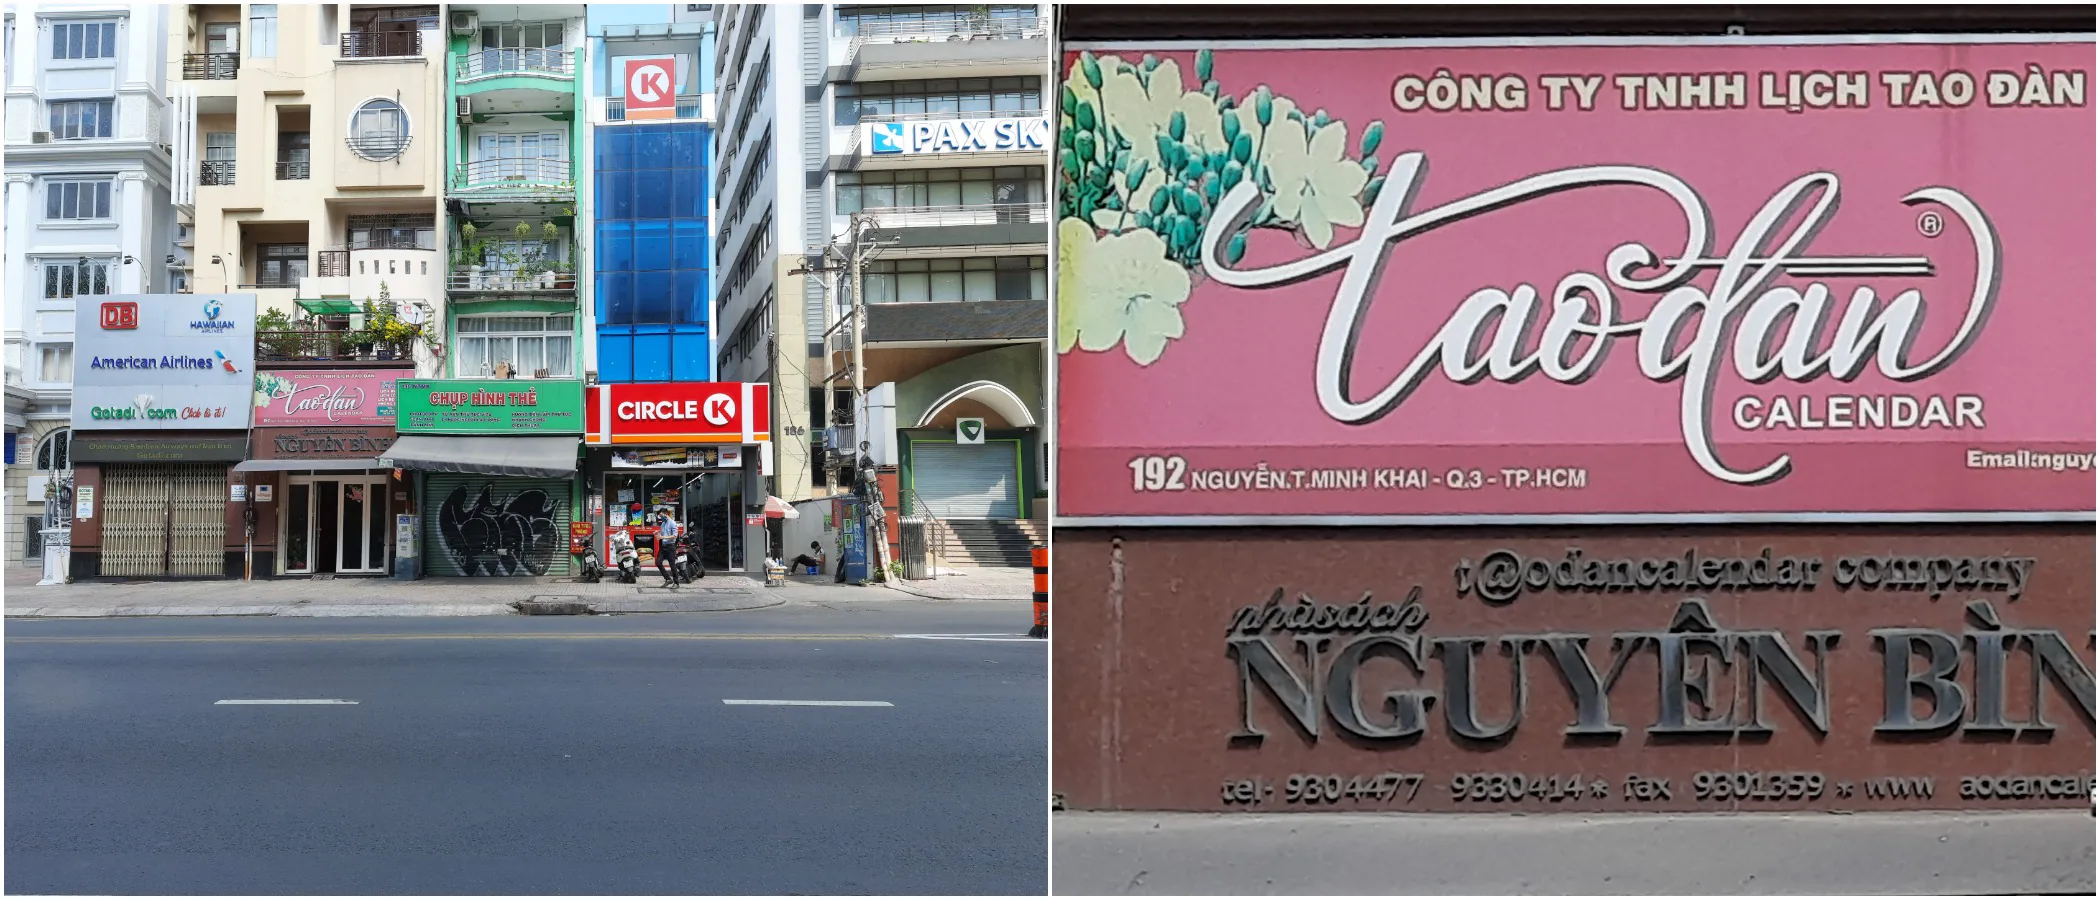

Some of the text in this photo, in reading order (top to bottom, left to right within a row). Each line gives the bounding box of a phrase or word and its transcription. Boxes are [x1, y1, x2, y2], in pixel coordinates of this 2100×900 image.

[637, 69, 668, 100] K
[1393, 63, 2087, 112] CÔNG TY TNHH LỊCH TAO ĐÀN
[912, 118, 1048, 151] PAX SK
[103, 304, 135, 328] DB
[190, 320, 235, 329] HAWAIIAN
[91, 355, 213, 370] American Airlines
[430, 386, 537, 409] CHỤP HÌNH THẺ
[617, 397, 734, 423] CIRCLE K
[1733, 394, 1986, 431] CALENDAR
[1127, 455, 1187, 490] 192
[1374, 467, 1427, 489] KHAI
[1446, 468, 1483, 489] Q.3
[1500, 467, 1587, 489] TP.HCM
[1833, 556, 2036, 600] company
[1226, 600, 1842, 748] NGUYÊN
[1285, 772, 1424, 804] 9304477
[1450, 773, 1585, 803] 9330414
[1624, 774, 1673, 802] fax
[1692, 771, 1827, 802] 9301359
[1864, 776, 1936, 800] www
